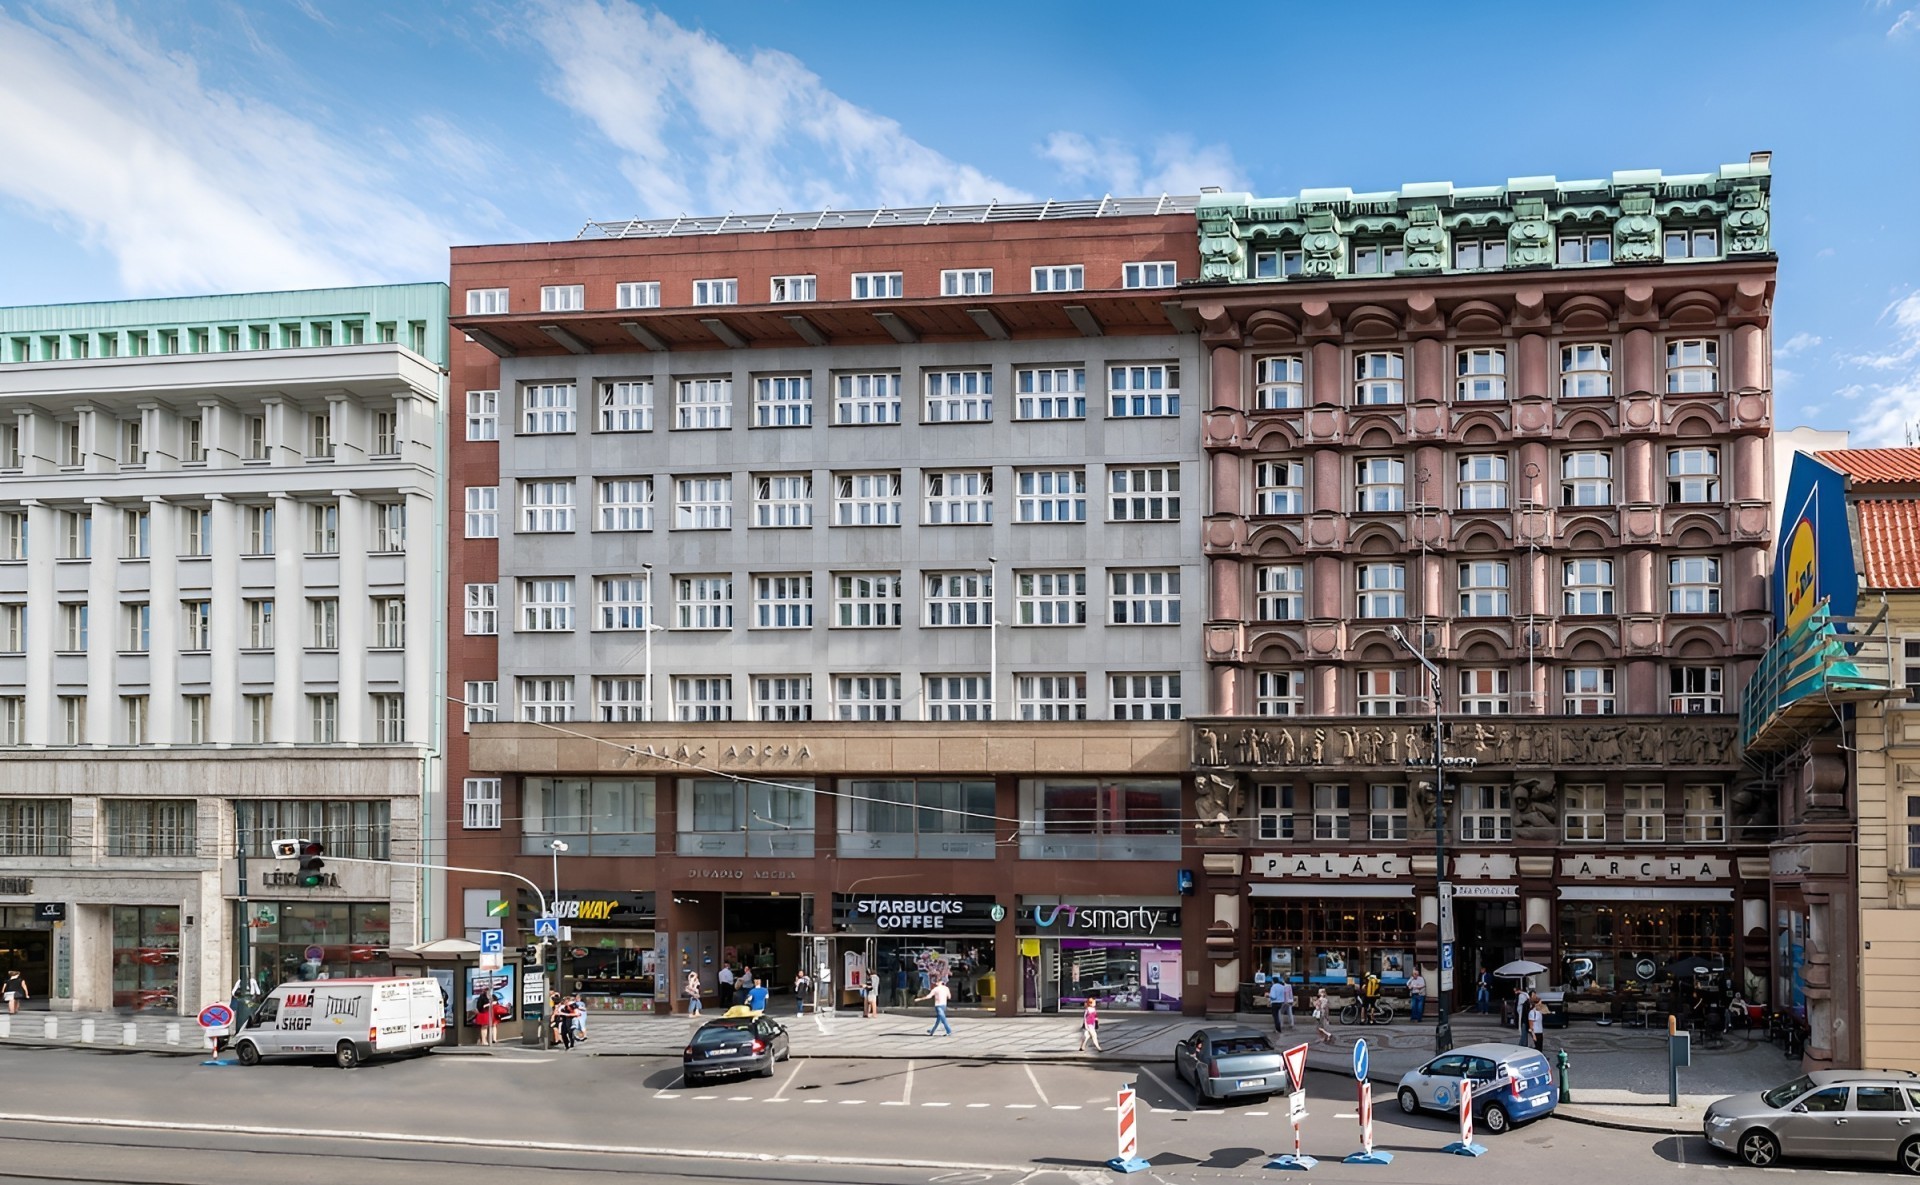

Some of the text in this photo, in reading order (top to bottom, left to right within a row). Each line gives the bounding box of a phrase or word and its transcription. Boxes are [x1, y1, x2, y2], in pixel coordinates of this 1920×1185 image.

[1267, 857, 1392, 873] PALÁC
[1579, 861, 1713, 876] ARCHA
[546, 900, 619, 919] SUBWAY
[857, 900, 963, 914] STARBUCKS
[877, 915, 944, 929] COFFEE
[1081, 905, 1160, 935] smarty
[281, 1017, 312, 1031] SHOP
